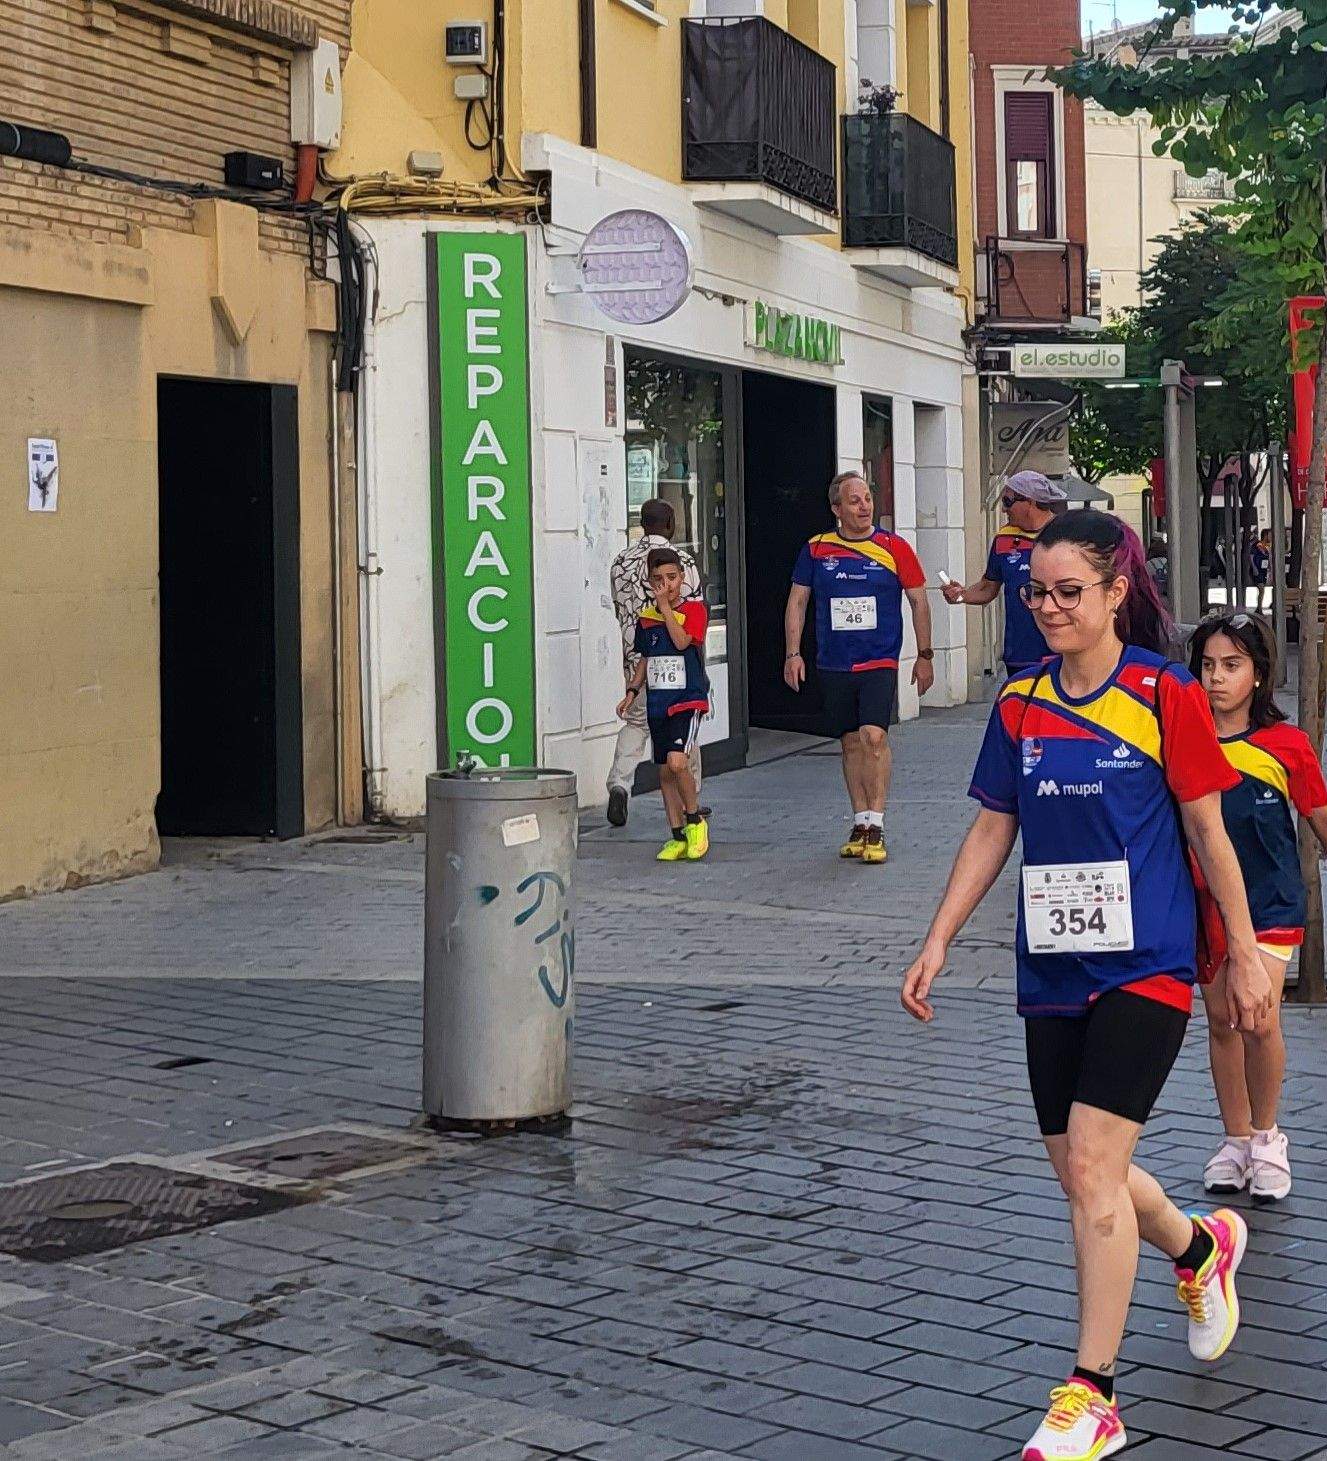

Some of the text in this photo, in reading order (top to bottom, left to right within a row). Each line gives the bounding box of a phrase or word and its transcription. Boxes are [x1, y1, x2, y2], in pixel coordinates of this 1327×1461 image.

[1020, 349, 1120, 366] el.estudio
[845, 613, 863, 624] 46
[653, 672, 677, 683] 716
[1095, 759, 1144, 769] Santander
[1063, 780, 1103, 797] mupol
[1049, 907, 1106, 936] 354
